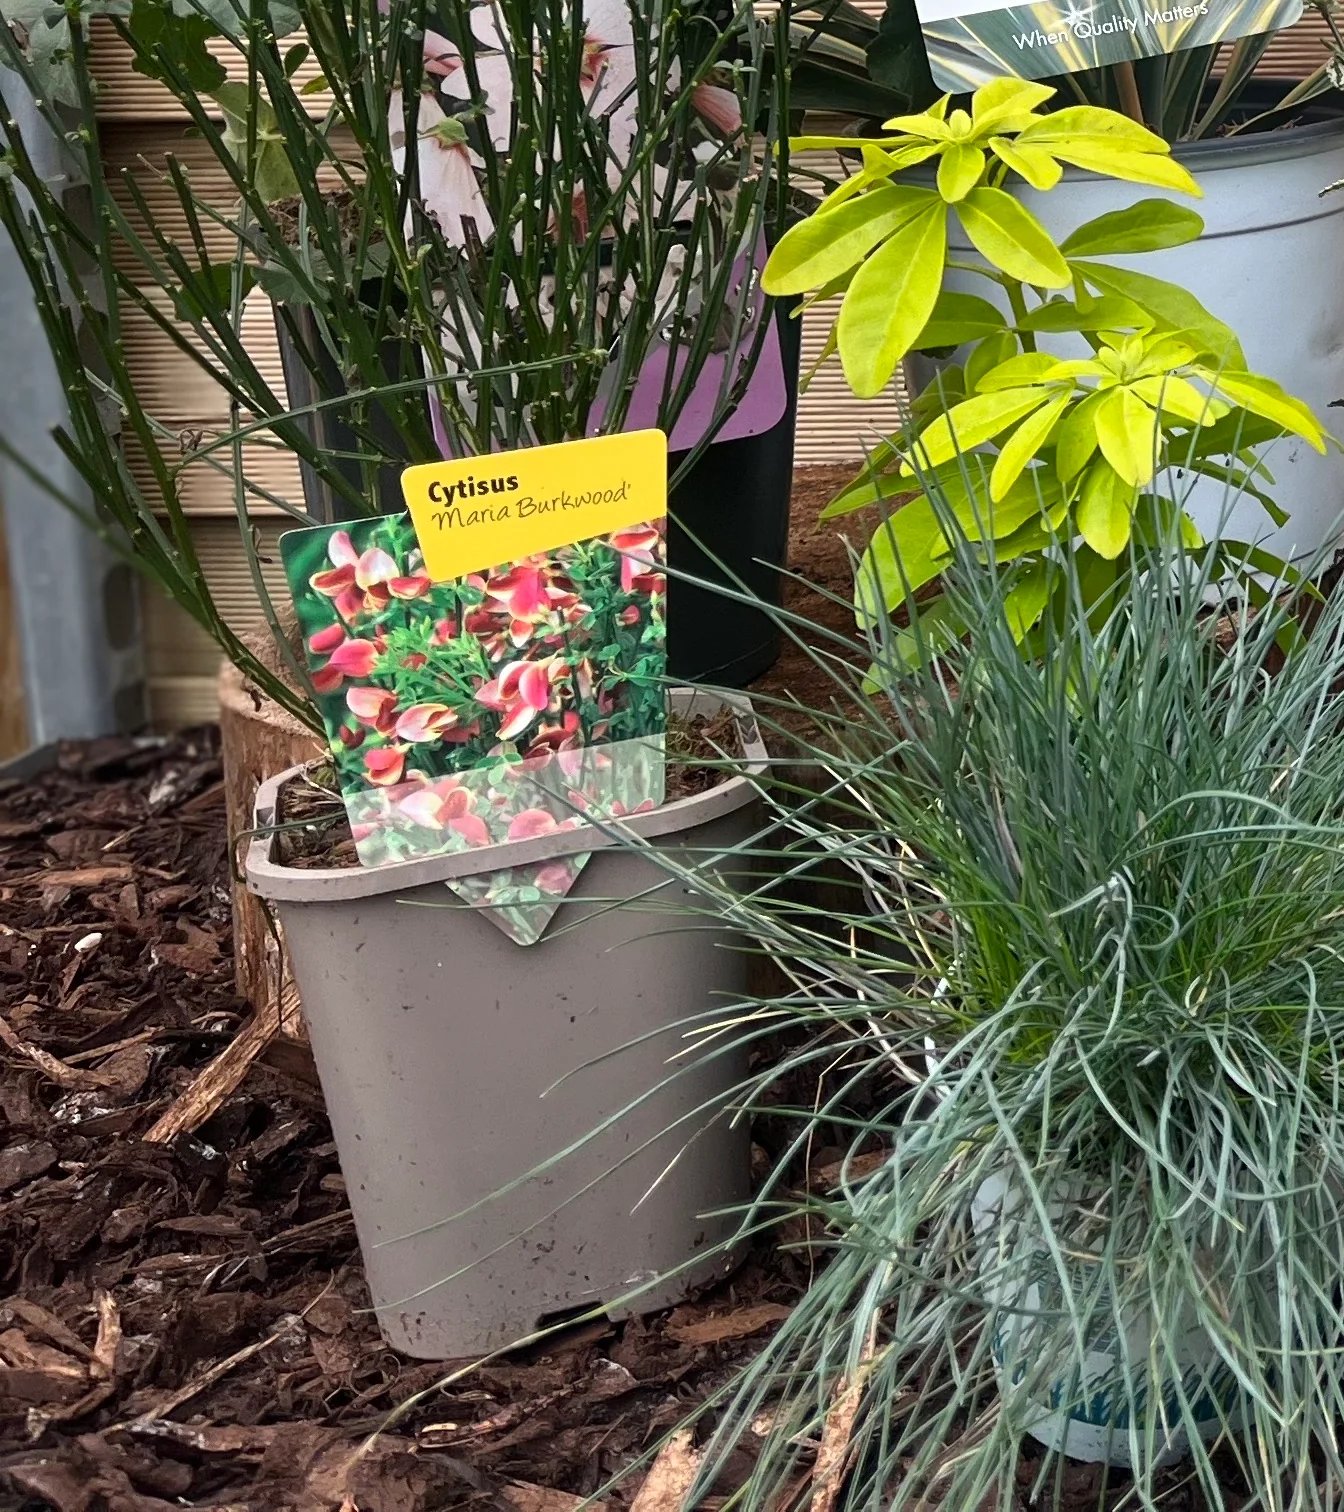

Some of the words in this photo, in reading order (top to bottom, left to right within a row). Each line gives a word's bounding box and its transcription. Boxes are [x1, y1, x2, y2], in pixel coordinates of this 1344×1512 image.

[1012, 30, 1069, 50] When
[1073, 15, 1138, 39] Quality
[1143, 2, 1209, 27] Matters
[428, 475, 519, 507] Cytisus
